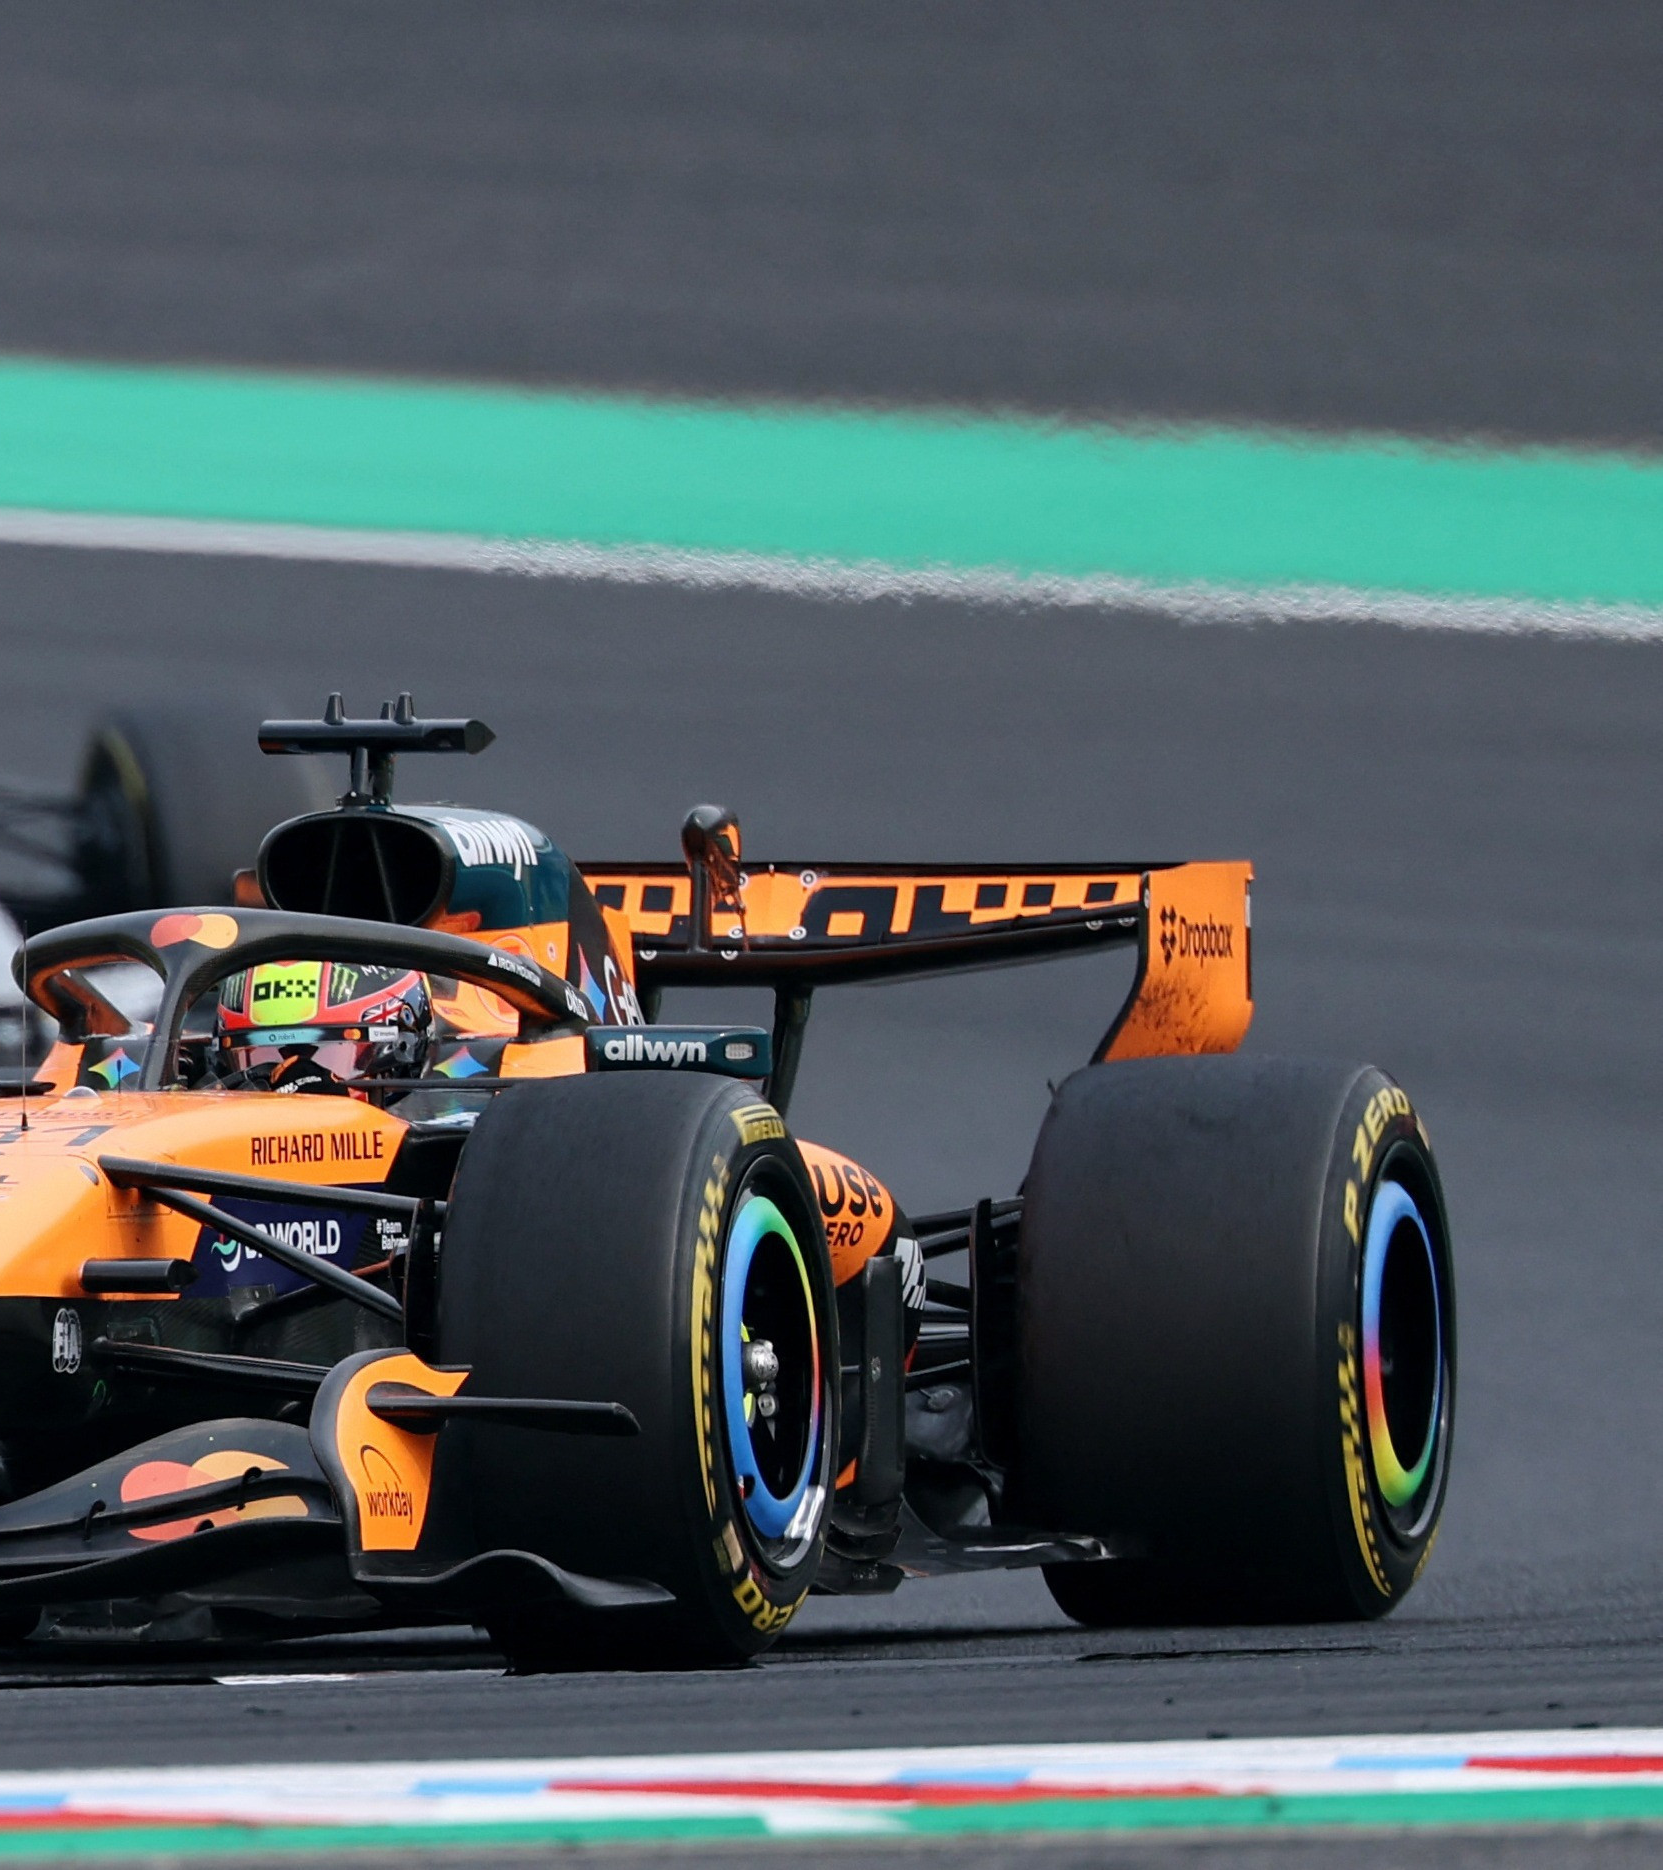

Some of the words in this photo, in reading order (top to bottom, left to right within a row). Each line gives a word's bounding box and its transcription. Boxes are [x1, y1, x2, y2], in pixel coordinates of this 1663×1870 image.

[442, 816, 539, 882] allwyn
[1180, 914, 1234, 968] Dropbox
[254, 979, 317, 1002] OKX
[604, 1035, 707, 1066] allwyn
[251, 1133, 325, 1166] RICHARD
[331, 1130, 384, 1160] MILLE
[1352, 1086, 1411, 1183] ZERO
[269, 1219, 341, 1256] WORLD
[376, 1218, 402, 1234] #Team
[826, 1221, 864, 1247] ERO
[365, 1482, 413, 1525] workday
